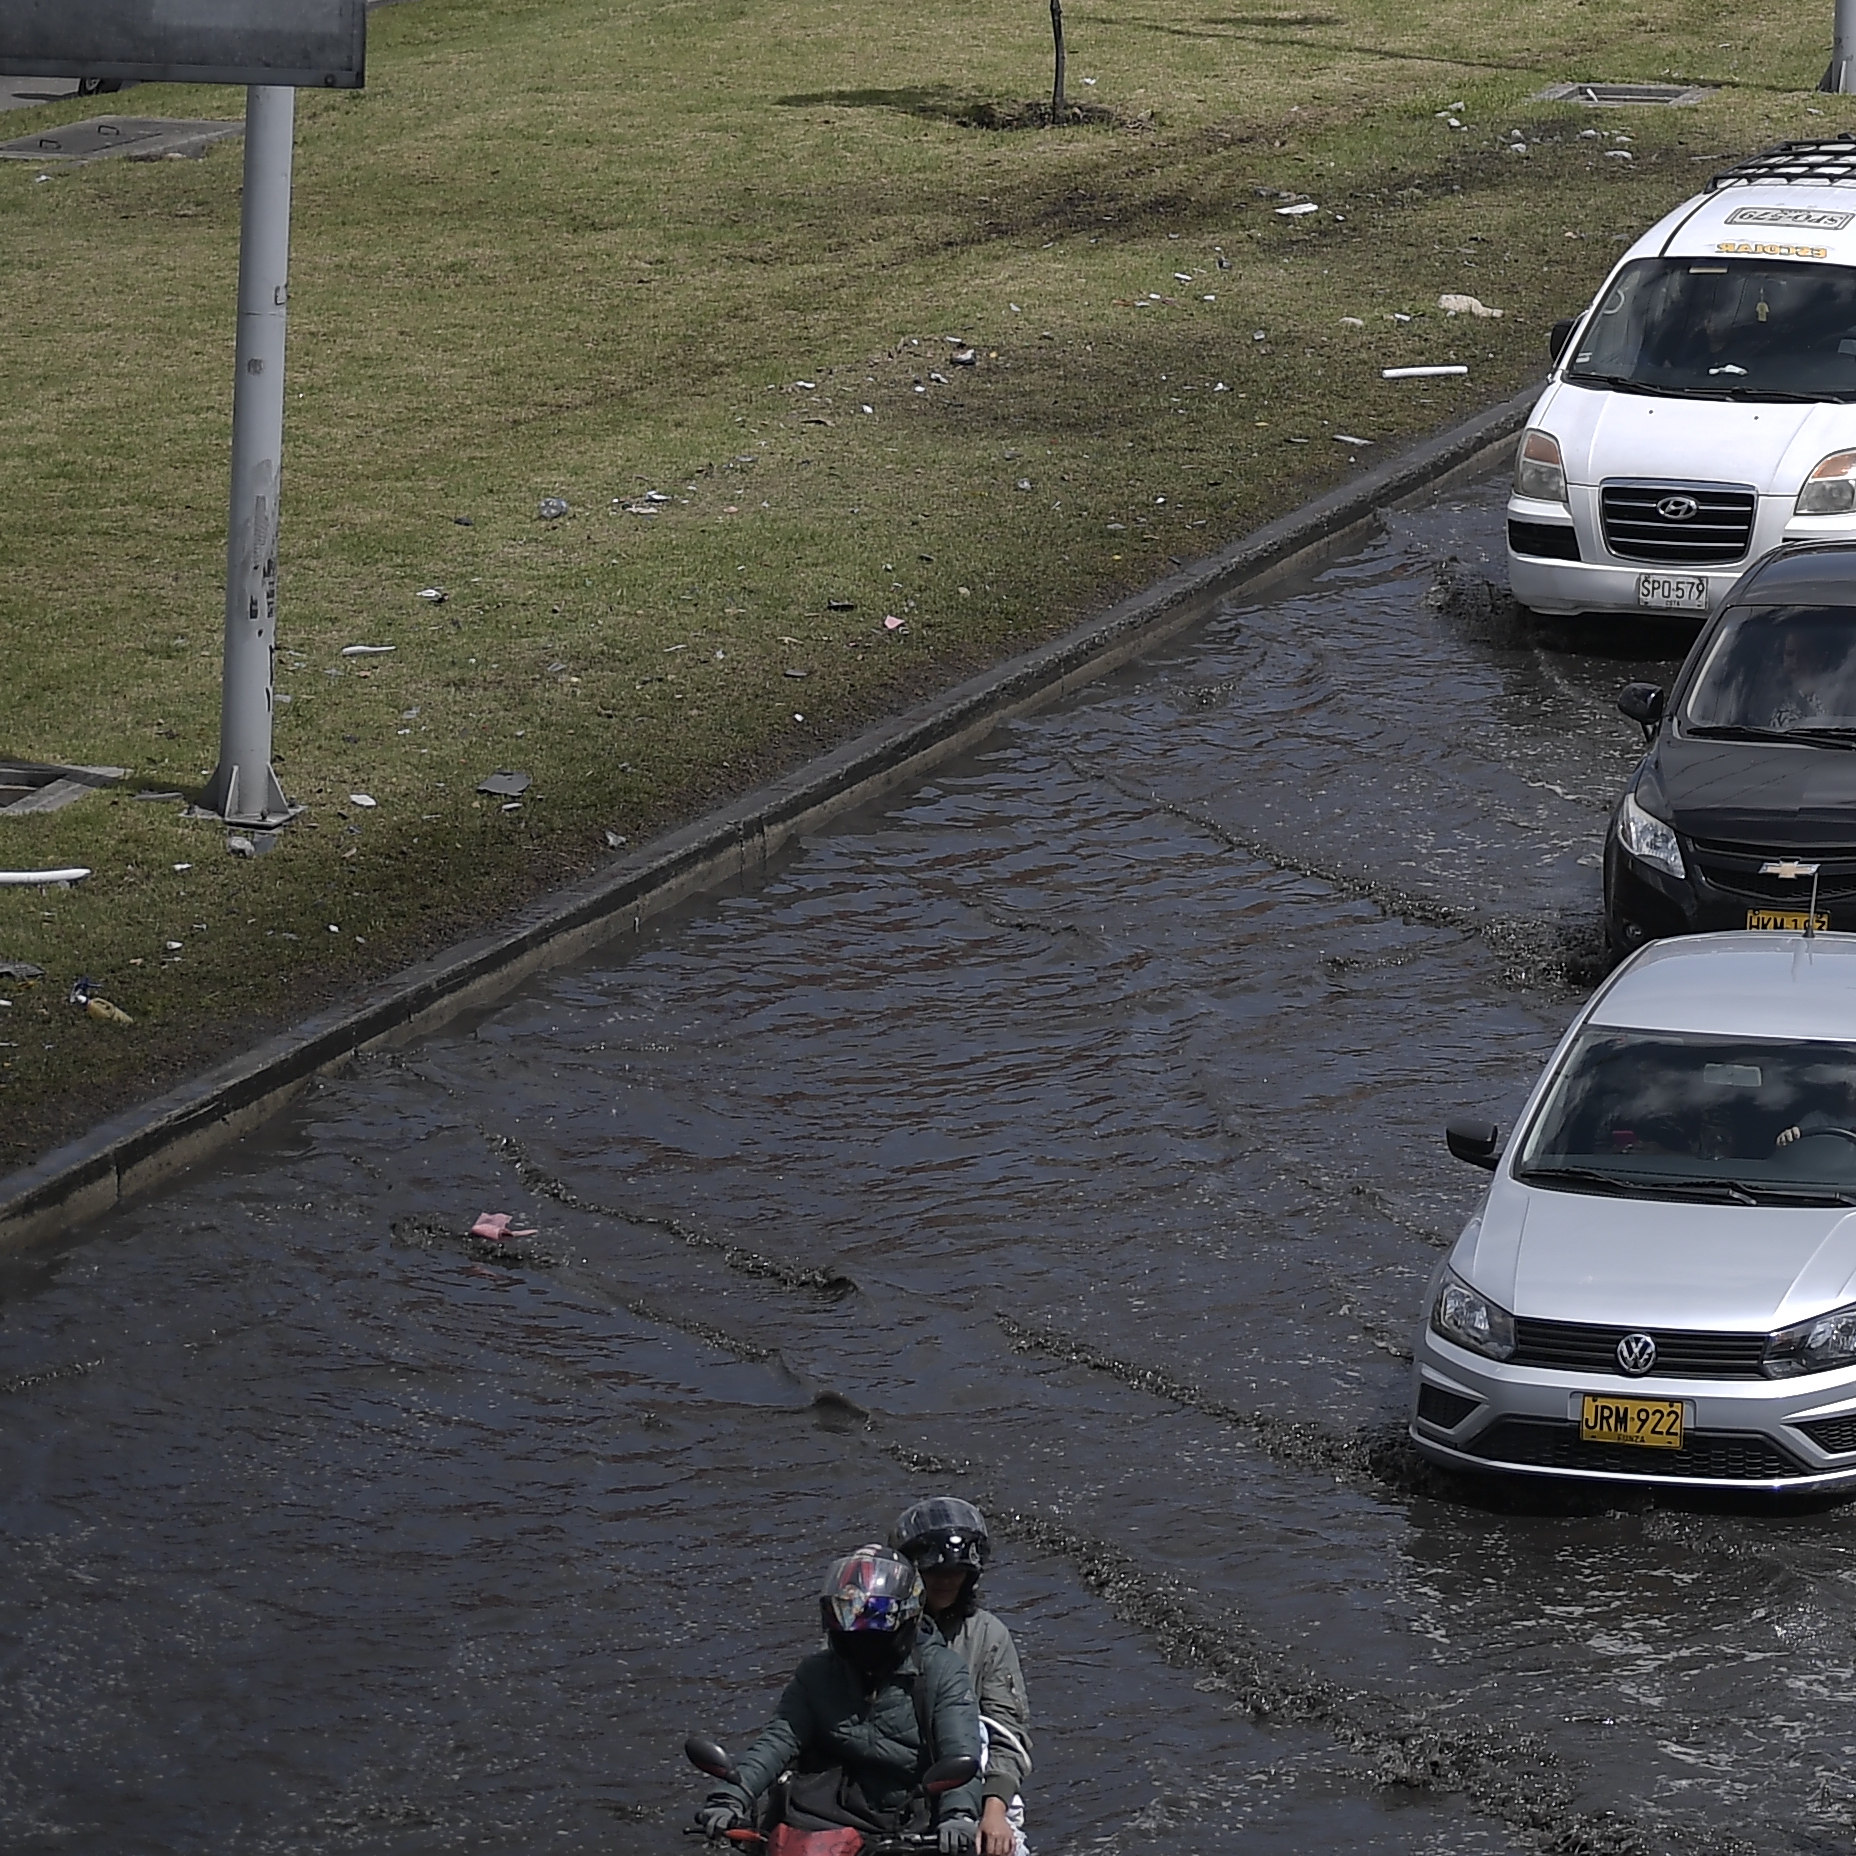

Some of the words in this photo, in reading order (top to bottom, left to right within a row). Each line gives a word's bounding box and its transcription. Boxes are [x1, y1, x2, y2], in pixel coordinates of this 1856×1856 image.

[1675, 580, 1705, 600] 579
[1749, 915, 1785, 930] HKM
[1584, 1404, 1629, 1433] JRM
[1636, 1407, 1680, 1437] 922
